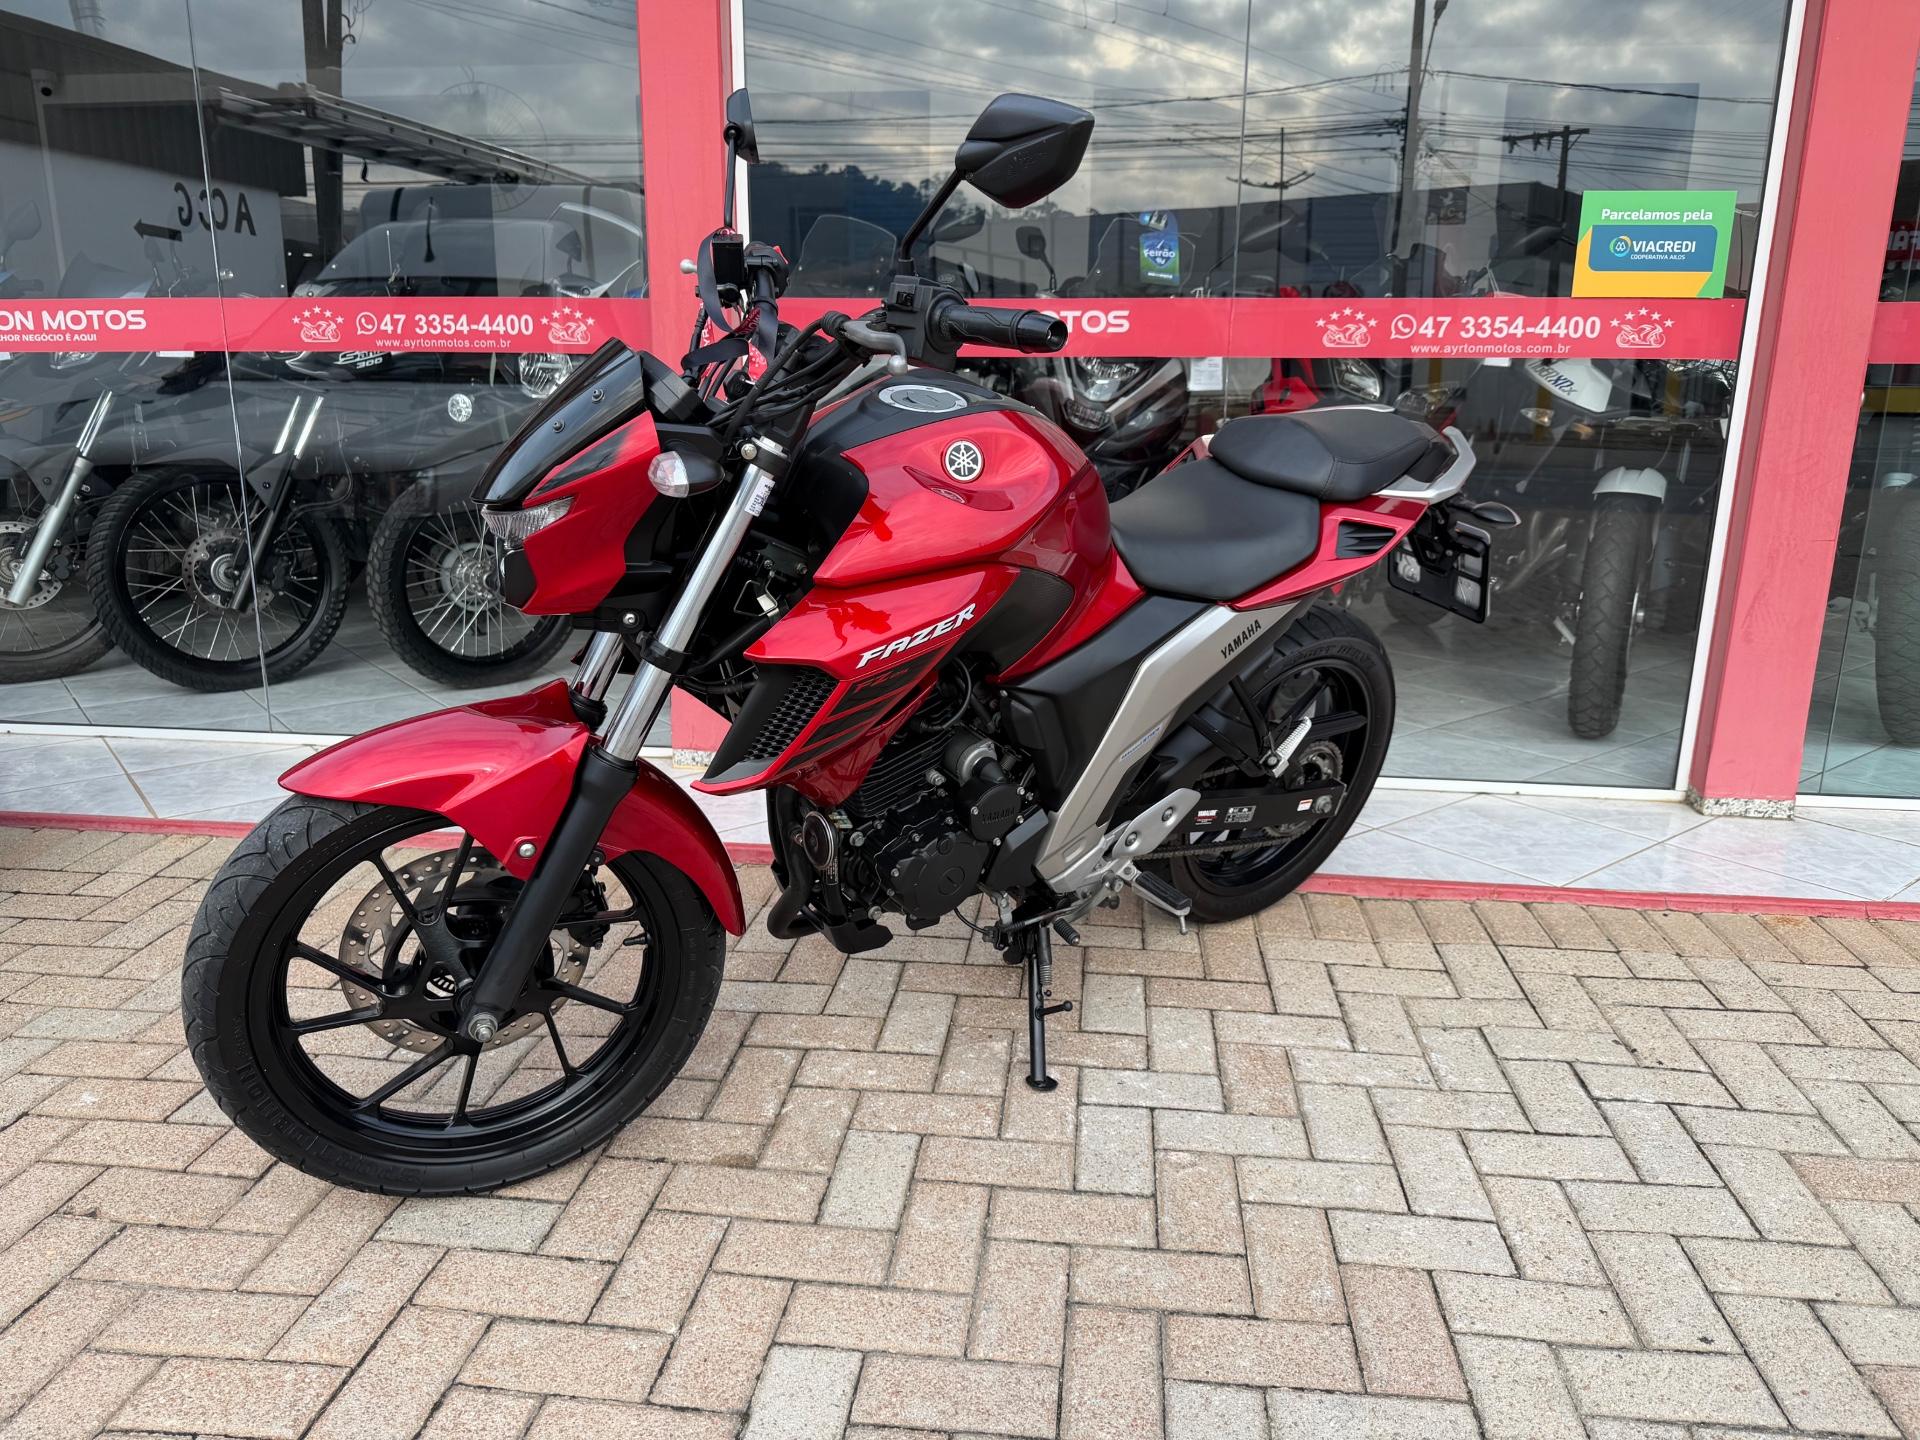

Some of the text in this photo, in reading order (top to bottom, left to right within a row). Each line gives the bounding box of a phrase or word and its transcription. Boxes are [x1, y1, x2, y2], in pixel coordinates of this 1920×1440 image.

[1601, 208, 1713, 222] Parcelamos pela
[1143, 248, 1176, 258] Feirão
[1632, 240, 1696, 253] VIACREDI
[41, 309, 147, 331] MOTOS
[380, 314, 534, 335] 47 3354-4400
[1040, 310, 1130, 333] TOS
[1418, 316, 1601, 339] 47 3354-4400
[22, 332, 64, 342] NEGÓCIO
[73, 333, 97, 342] AQUI
[375, 338, 511, 349] www.ayrtonmotos.com.br
[1410, 343, 1571, 355] www.ayrtonmotos.com.br
[356, 357, 383, 369] 300
[856, 603, 976, 669] FAZER
[1220, 619, 1262, 659] YAMAHA
